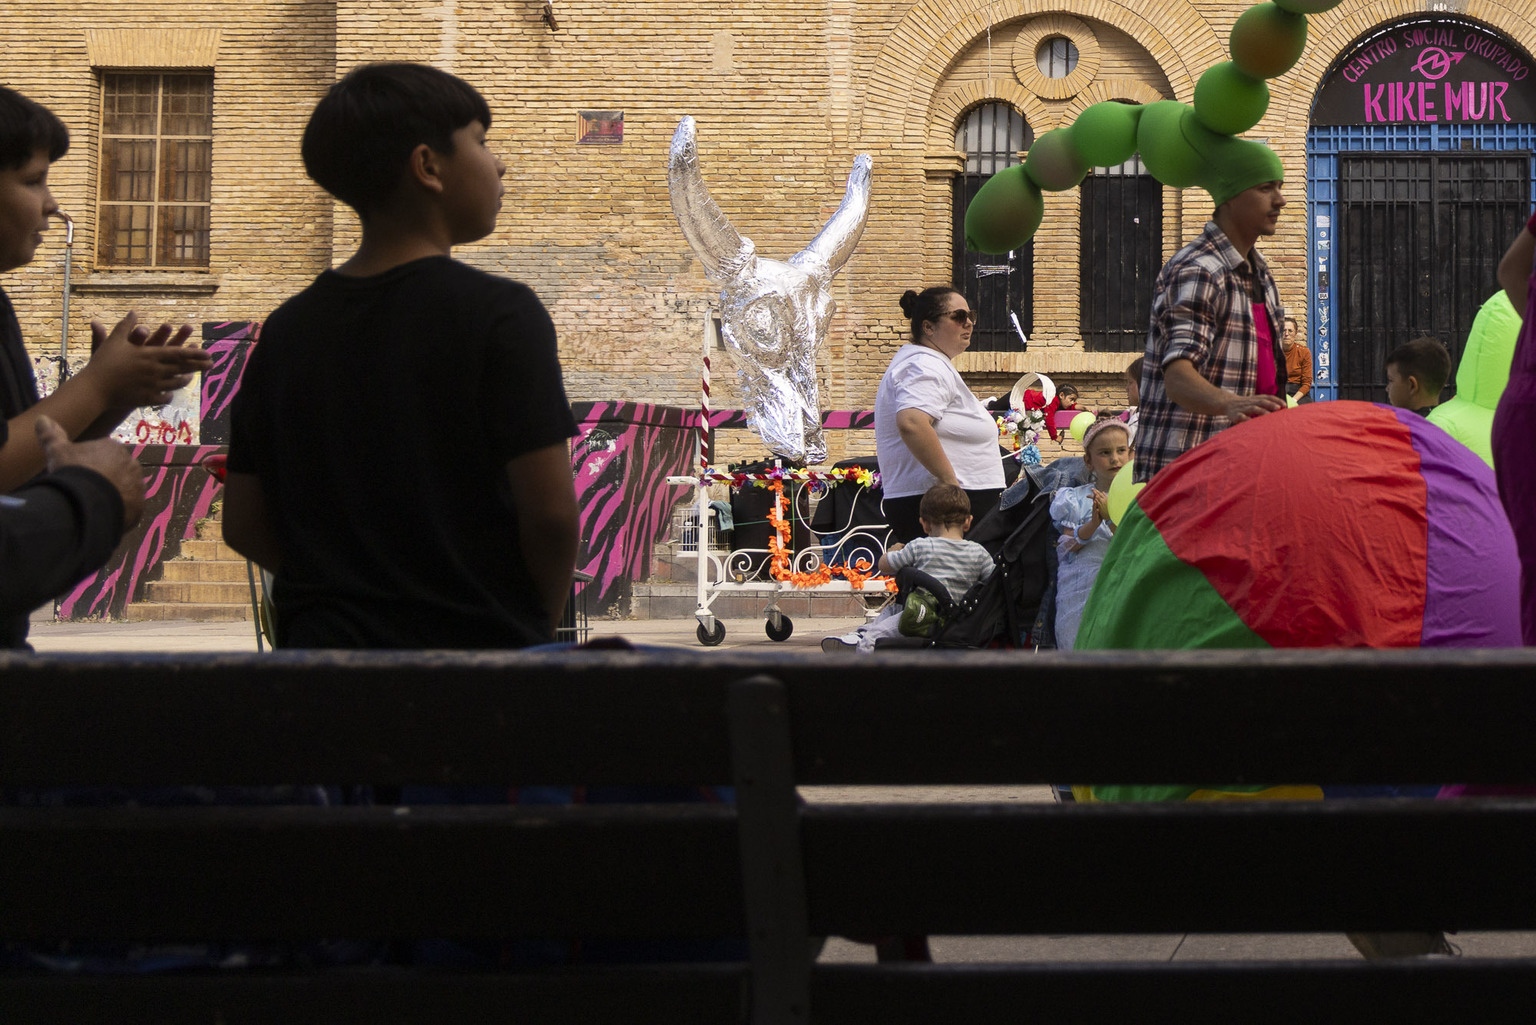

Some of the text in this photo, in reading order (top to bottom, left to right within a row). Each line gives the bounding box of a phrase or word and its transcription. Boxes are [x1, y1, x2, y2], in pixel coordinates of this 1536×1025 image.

[1342, 27, 1529, 83] CENTRO SOCIAL OKUPADO
[1364, 81, 1512, 122] KIKE MUR
